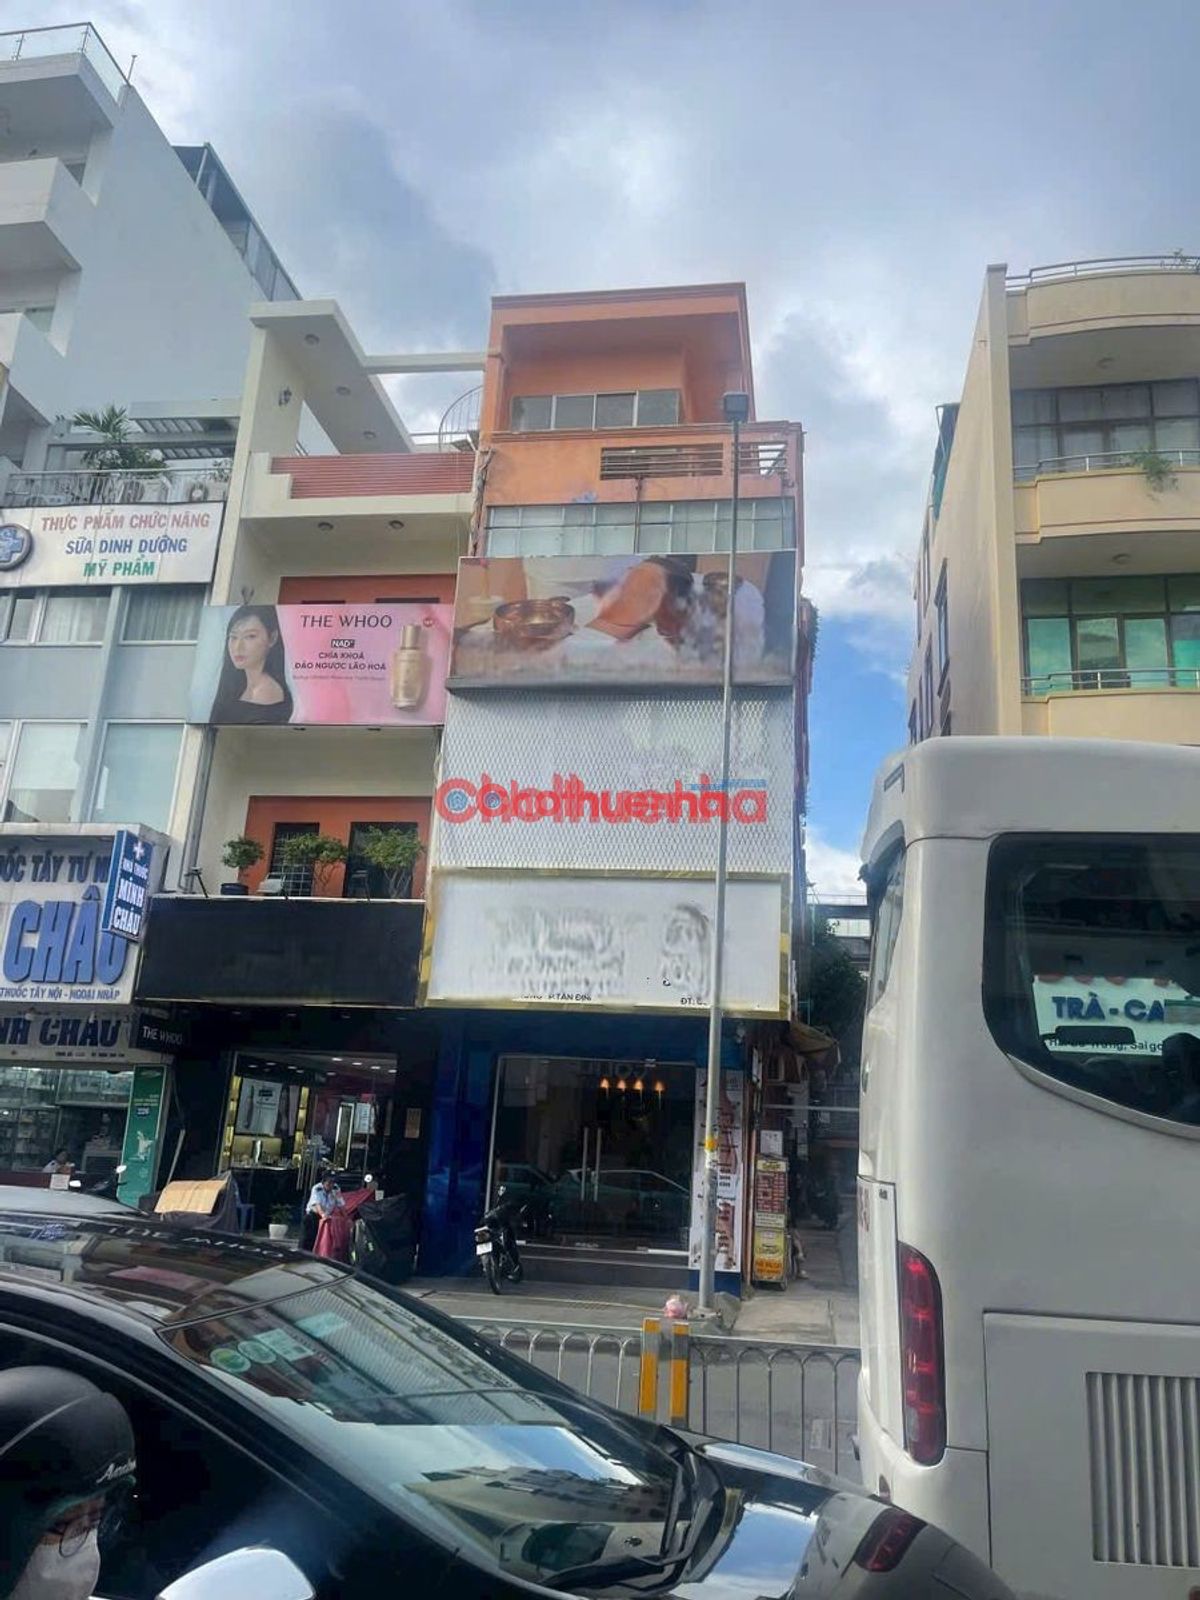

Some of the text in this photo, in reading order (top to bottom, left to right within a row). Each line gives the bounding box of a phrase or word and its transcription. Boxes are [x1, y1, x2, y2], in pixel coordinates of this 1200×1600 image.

[41, 514, 77, 534] THỰC
[84, 508, 125, 530] PHẨM
[130, 510, 168, 529] CHỨC
[66, 535, 188, 555] SỮA DINH DƯỠNG
[84, 554, 155, 576] MỸ PHẨM
[301, 614, 392, 628] THE WHOO
[3, 884, 128, 985] CHÂU
[1052, 991, 1105, 1021] TRÀ
[143, 1025, 159, 1040] THE
